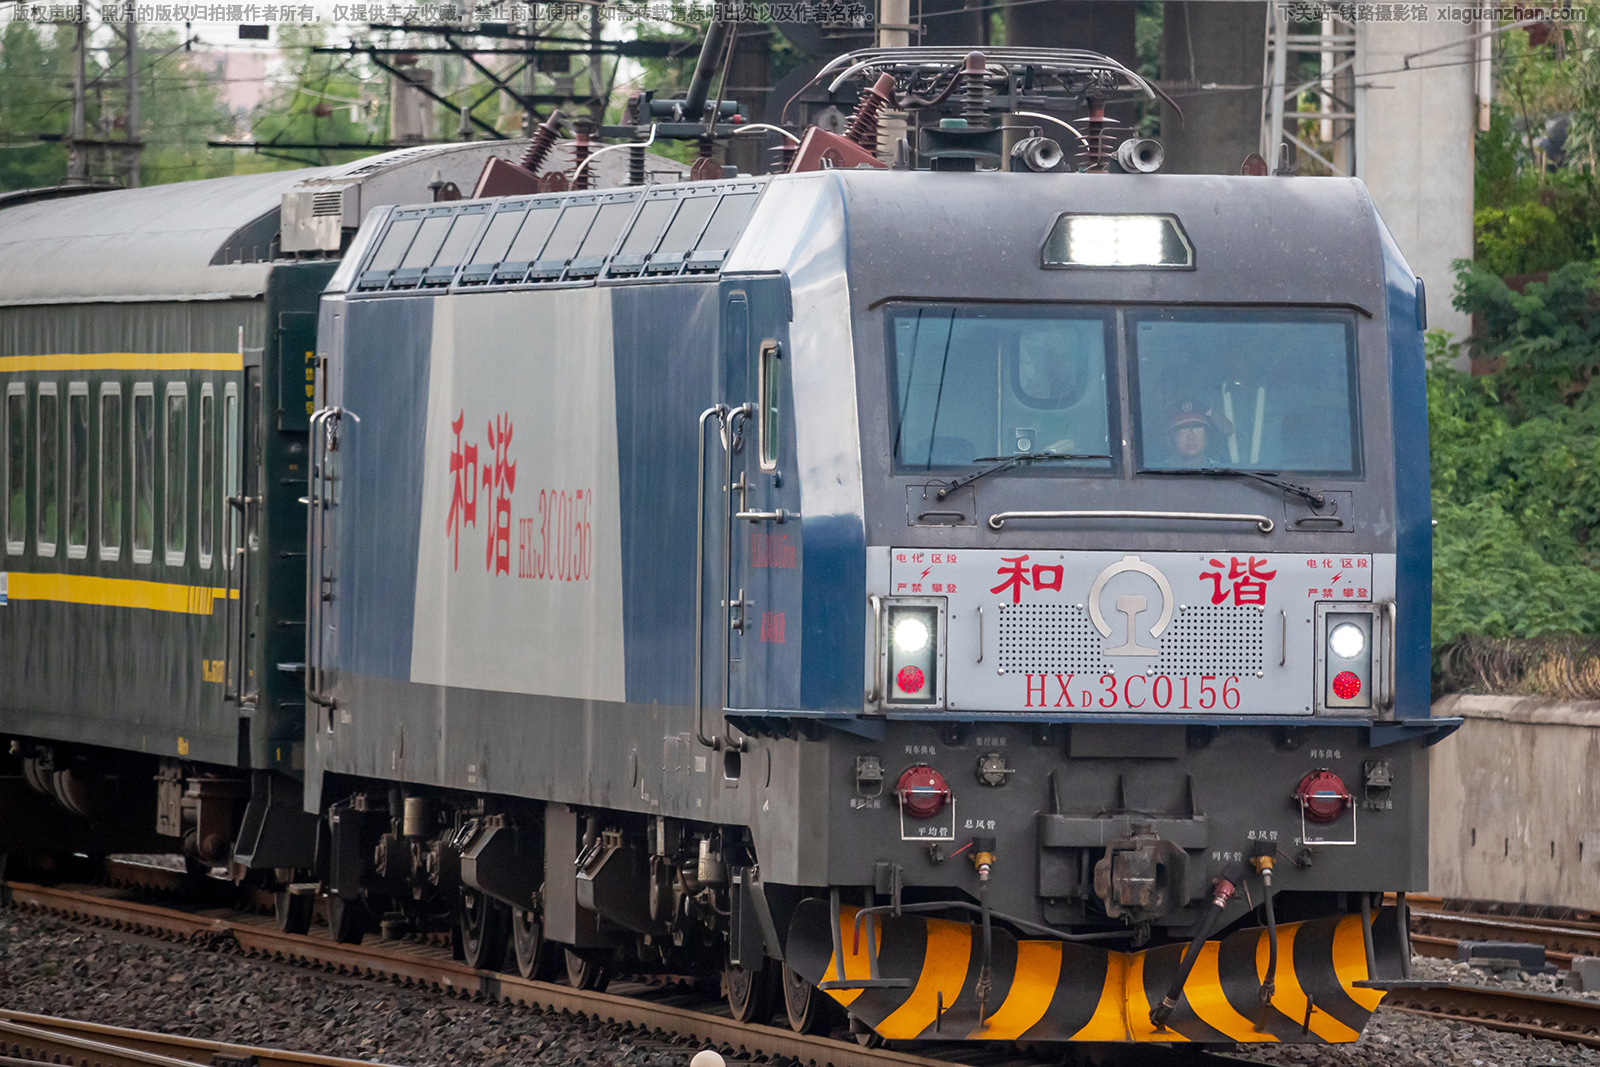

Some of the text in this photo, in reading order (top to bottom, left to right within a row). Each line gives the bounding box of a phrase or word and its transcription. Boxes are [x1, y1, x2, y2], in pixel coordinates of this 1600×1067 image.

[446, 408, 517, 577] 和谐
[990, 554, 1277, 606] 和 谐
[1025, 673, 1241, 710] HXD3C0156
[904, 745, 936, 755] 列车供电
[1310, 750, 1342, 759] 列车供电
[964, 819, 996, 830] 总风管
[917, 827, 949, 837] 平均管
[1246, 830, 1279, 841] 总风管
[1211, 851, 1243, 862] 列车管
